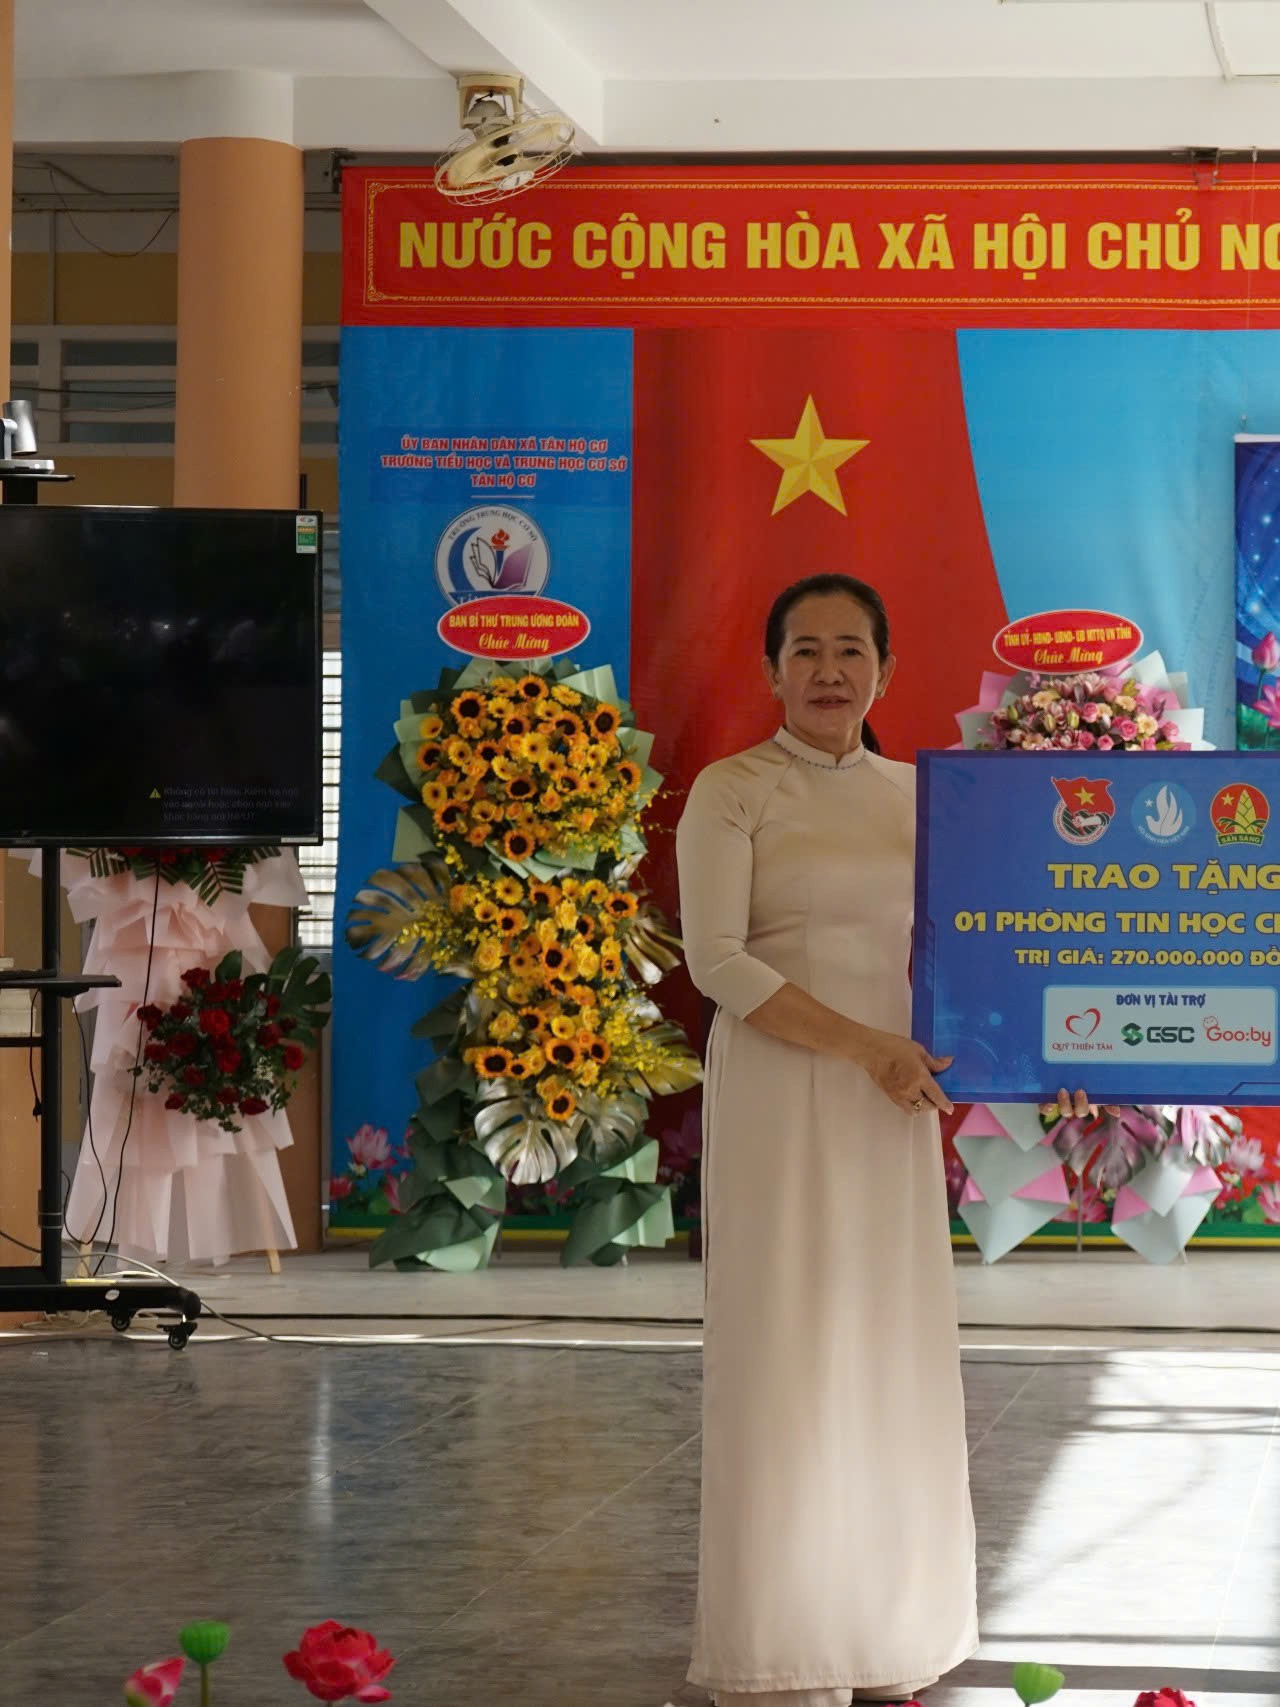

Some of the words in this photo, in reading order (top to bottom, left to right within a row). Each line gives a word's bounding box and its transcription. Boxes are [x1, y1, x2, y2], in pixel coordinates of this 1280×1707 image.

[400, 213, 552, 269] NƯỚC
[573, 213, 726, 279] CỘNG
[746, 211, 860, 269] HÒA
[878, 213, 955, 269] XÃ
[973, 213, 1066, 280] HỘI
[1087, 208, 1200, 270] CHỦ
[421, 438, 449, 450] BAN
[451, 436, 488, 451] NHÂN
[490, 436, 516, 451] DÂN
[519, 436, 536, 451] XÃ
[540, 436, 565, 451] TÂN
[568, 437, 586, 454] HỘ
[589, 438, 608, 452] CƠ
[381, 453, 433, 469] TRƯỜNG
[435, 452, 463, 469] TIỂU
[465, 456, 492, 471] HỌC
[494, 454, 510, 469] VÀ
[513, 456, 556, 469] TRUNG
[558, 457, 585, 472] HỌC
[587, 457, 607, 471] CƠ
[608, 455, 628, 472] SỞ
[471, 472, 496, 487] TÂN
[497, 472, 515, 489] HỘ
[517, 473, 536, 488] CƠ
[449, 614, 467, 627] BAN
[481, 613, 499, 627] THƯ
[500, 614, 528, 627] TRUNG
[556, 611, 579, 627] ĐOÀN
[1047, 863, 1161, 890] TRAO
[954, 911, 987, 933] 01
[996, 908, 1106, 934] PHÒNG
[1115, 911, 1170, 934] TIN
[1178, 912, 1246, 937] HỌC
[1014, 949, 1050, 967] TRỊ
[1056, 946, 1104, 966] GIÁ:
[1110, 949, 1244, 967] 270.000.000
[1116, 993, 1140, 1006] ĐƠN
[1144, 993, 1156, 1008] VỊ
[1159, 993, 1178, 1006] TÀI
[1182, 993, 1206, 1008] TRỢ
[1147, 1026, 1195, 1043] GSC
[1205, 1026, 1272, 1047] Goo:by
